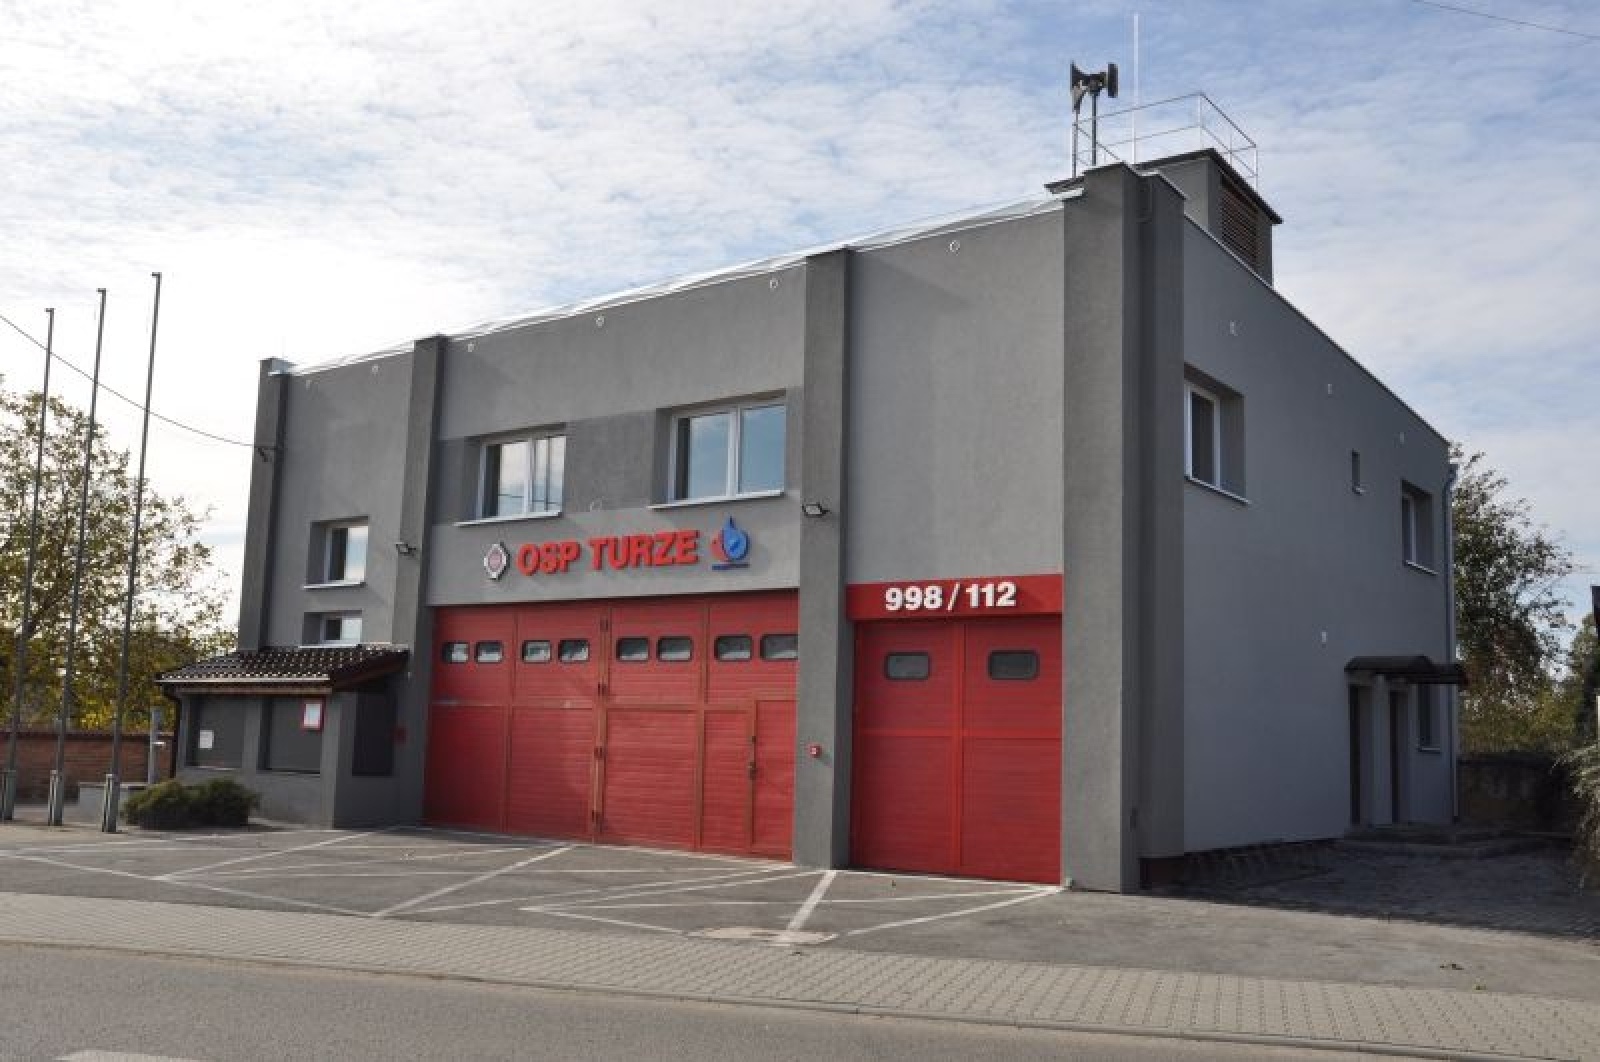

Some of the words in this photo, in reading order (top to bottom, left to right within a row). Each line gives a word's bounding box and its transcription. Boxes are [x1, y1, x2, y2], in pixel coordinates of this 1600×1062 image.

[517, 540, 581, 576] OSP
[588, 529, 699, 571] TURZE
[885, 585, 943, 611] 998
[946, 582, 961, 611] /
[965, 581, 1017, 609] 112
